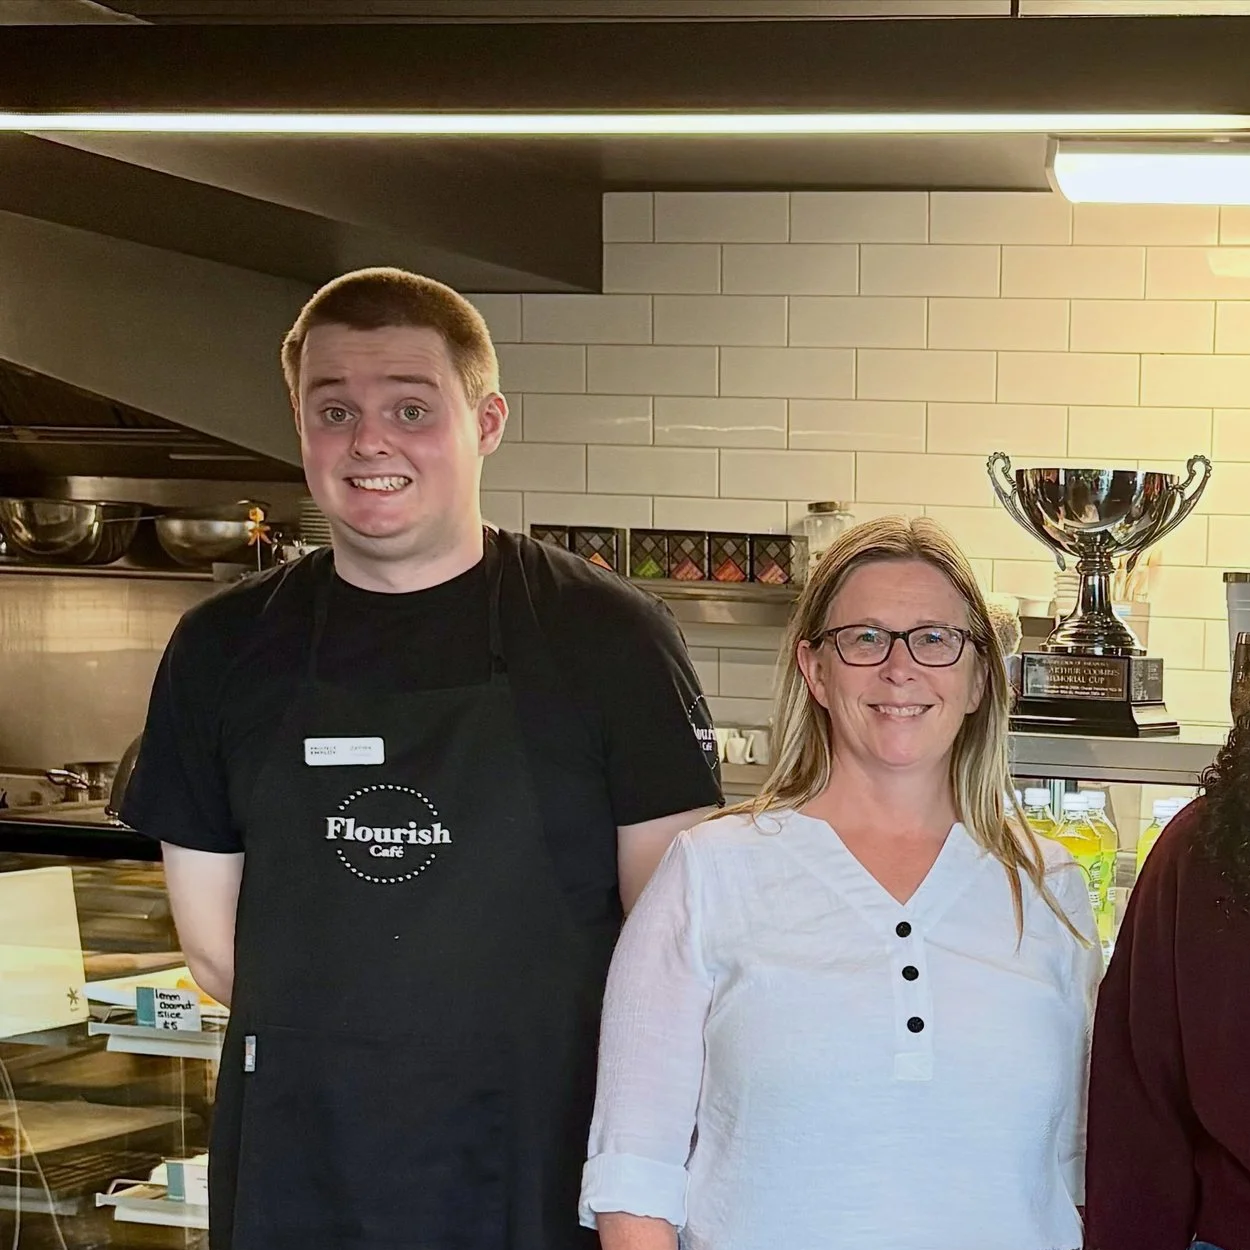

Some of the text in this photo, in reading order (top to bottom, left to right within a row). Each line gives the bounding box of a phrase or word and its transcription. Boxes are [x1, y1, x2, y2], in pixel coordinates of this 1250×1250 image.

[1048, 667, 1081, 675] ARTHUR
[1088, 676, 1105, 685] CUP
[325, 816, 452, 845] Flourish
[369, 844, 404, 858] Café
